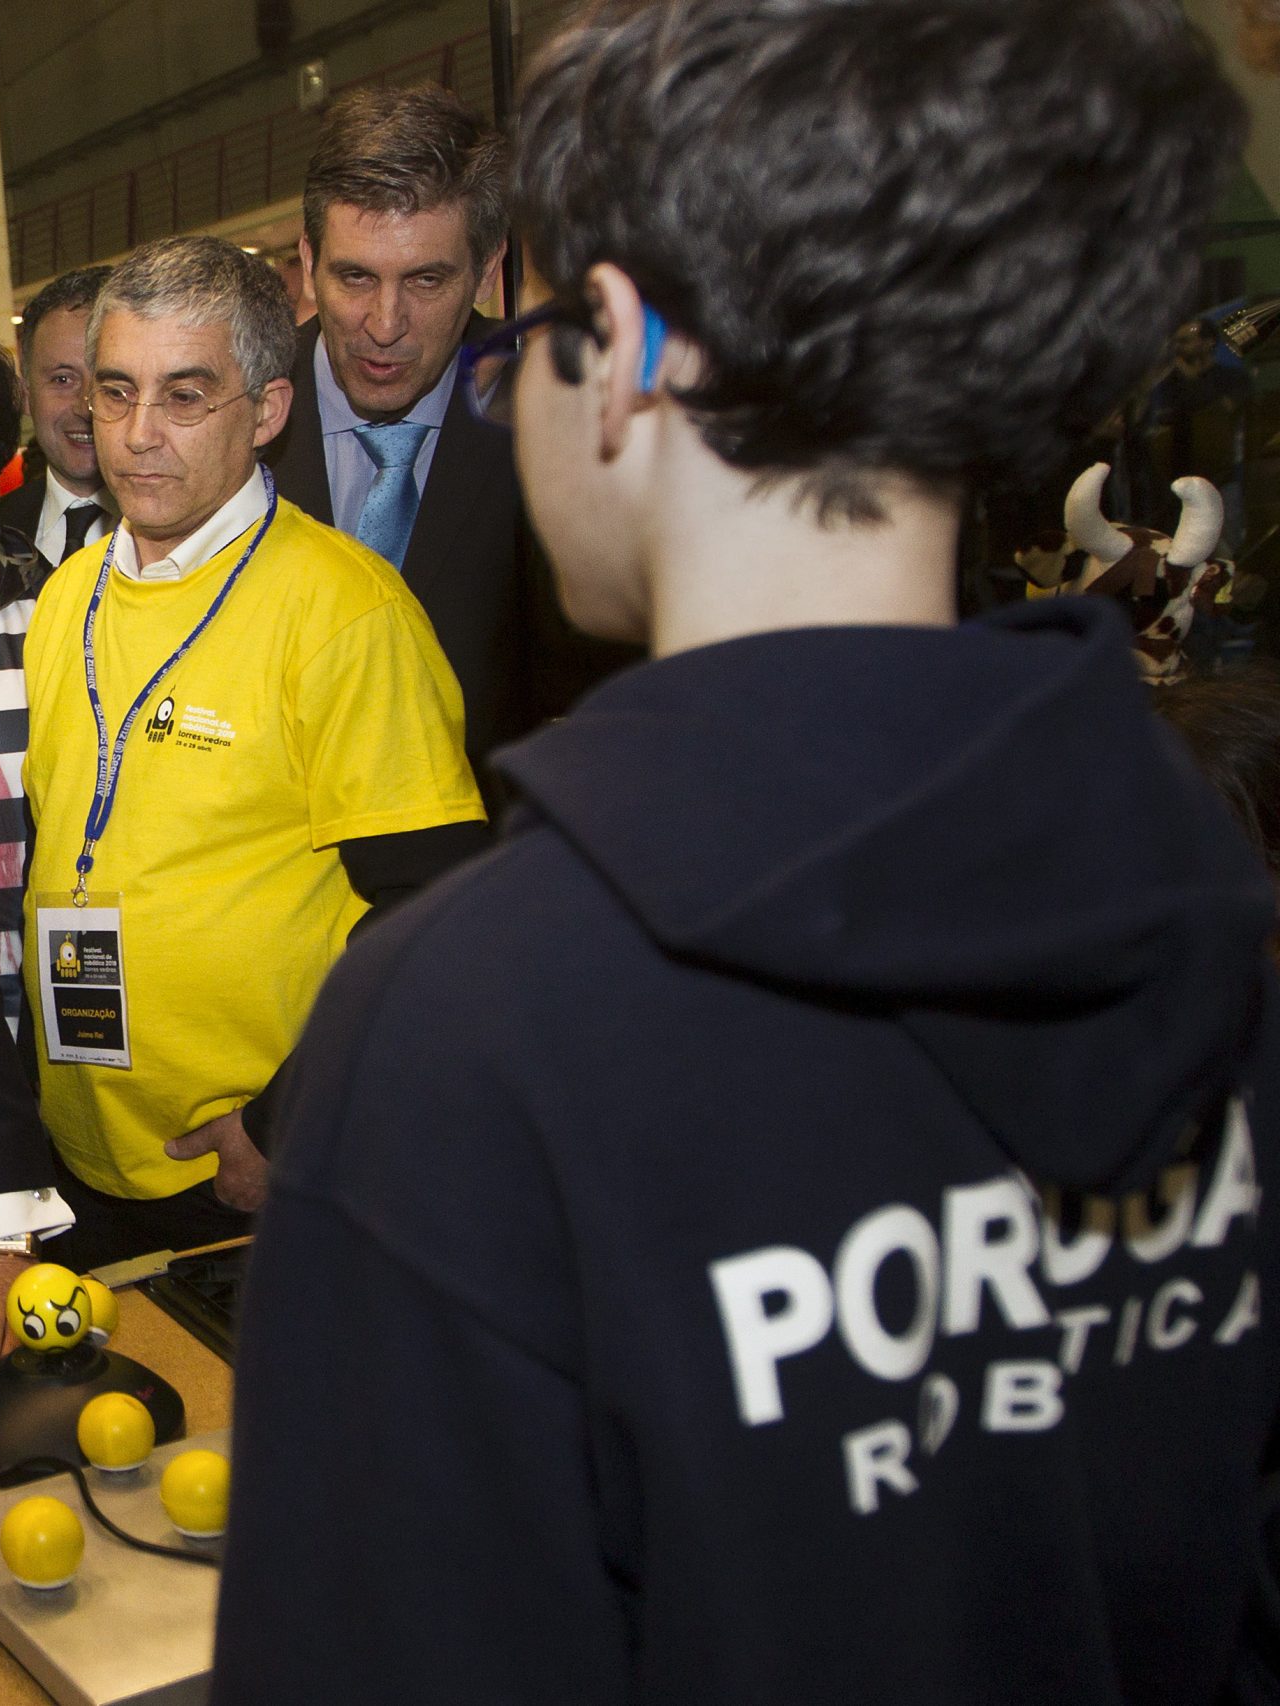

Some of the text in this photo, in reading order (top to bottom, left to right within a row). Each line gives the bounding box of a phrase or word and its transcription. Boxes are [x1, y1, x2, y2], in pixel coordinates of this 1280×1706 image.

[95, 565, 109, 599] Allianz
[85, 610, 96, 691] Allianz Seguros
[94, 703, 108, 796] Allianz Seguros
[106, 707, 139, 797] Allianz Seguros
[178, 730, 232, 747] torres vedras
[61, 1008, 116, 1020] ORGANIZAÇÃO
